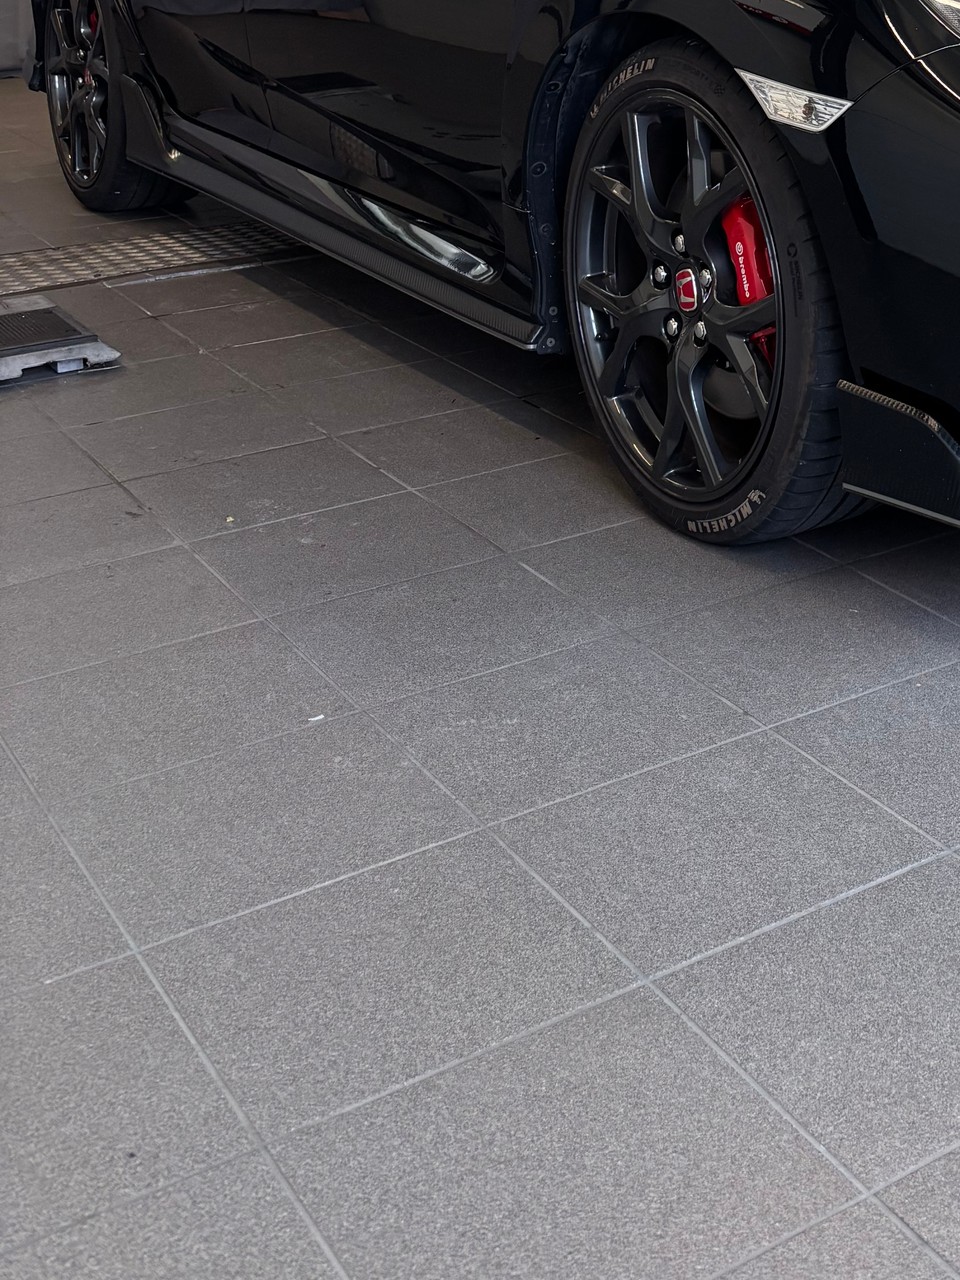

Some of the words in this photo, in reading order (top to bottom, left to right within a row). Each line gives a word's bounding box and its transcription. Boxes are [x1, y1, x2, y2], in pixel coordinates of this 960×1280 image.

[599, 58, 656, 105] MICHELIN
[738, 256, 750, 298] brembo
[687, 501, 753, 533] MICHELIN
